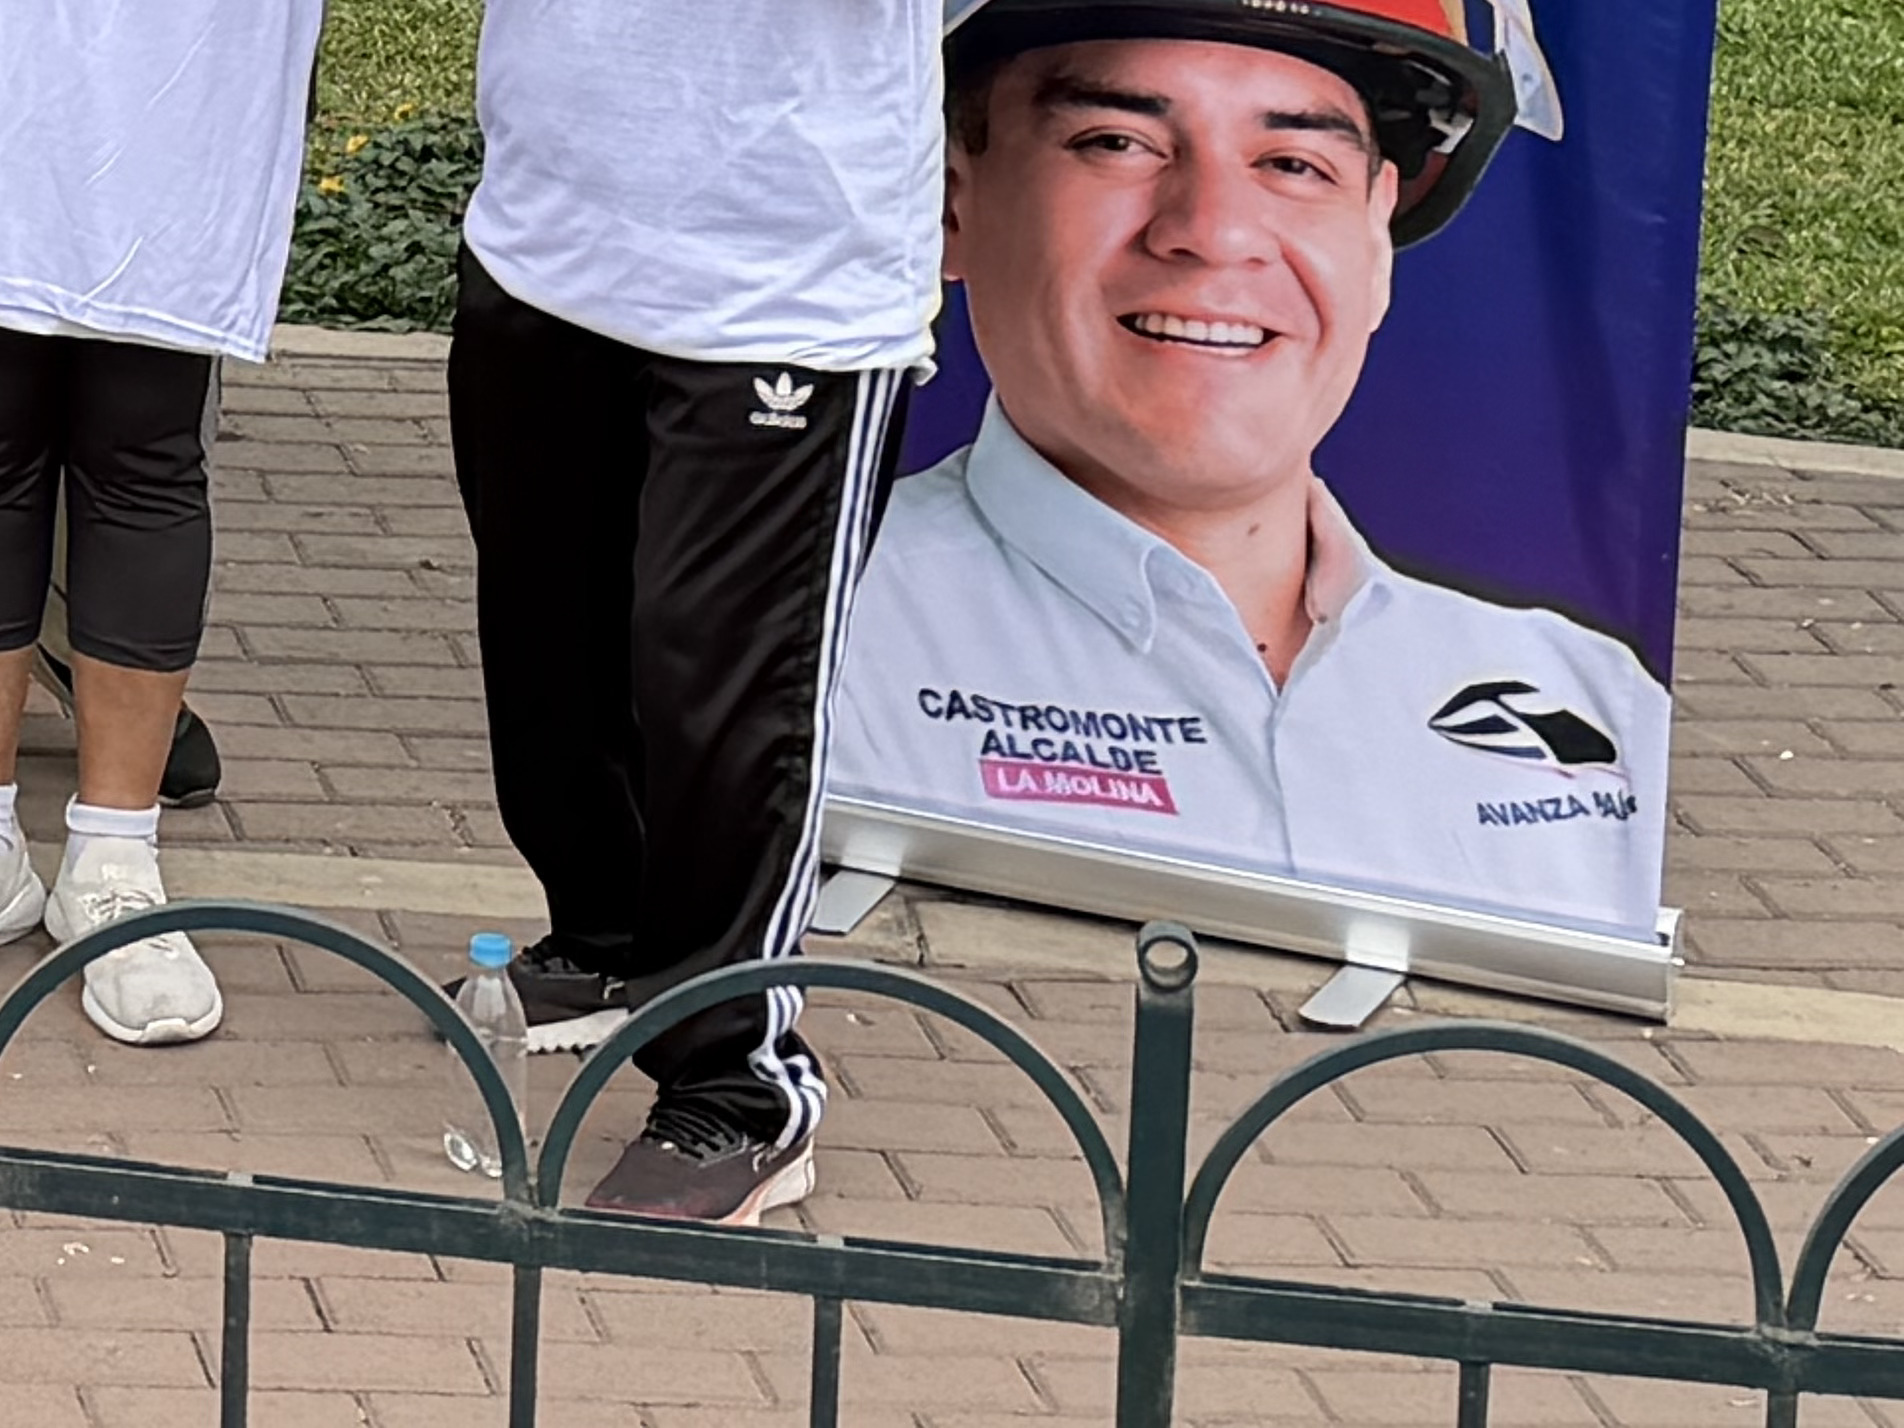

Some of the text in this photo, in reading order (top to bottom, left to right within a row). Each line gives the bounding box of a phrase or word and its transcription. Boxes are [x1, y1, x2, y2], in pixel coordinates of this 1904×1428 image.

[917, 687, 1208, 745] CASTROMONTE
[980, 728, 1163, 776] ALCALDE
[997, 767, 1165, 807] LA MOLINA
[1476, 793, 1592, 827] AVANZA
